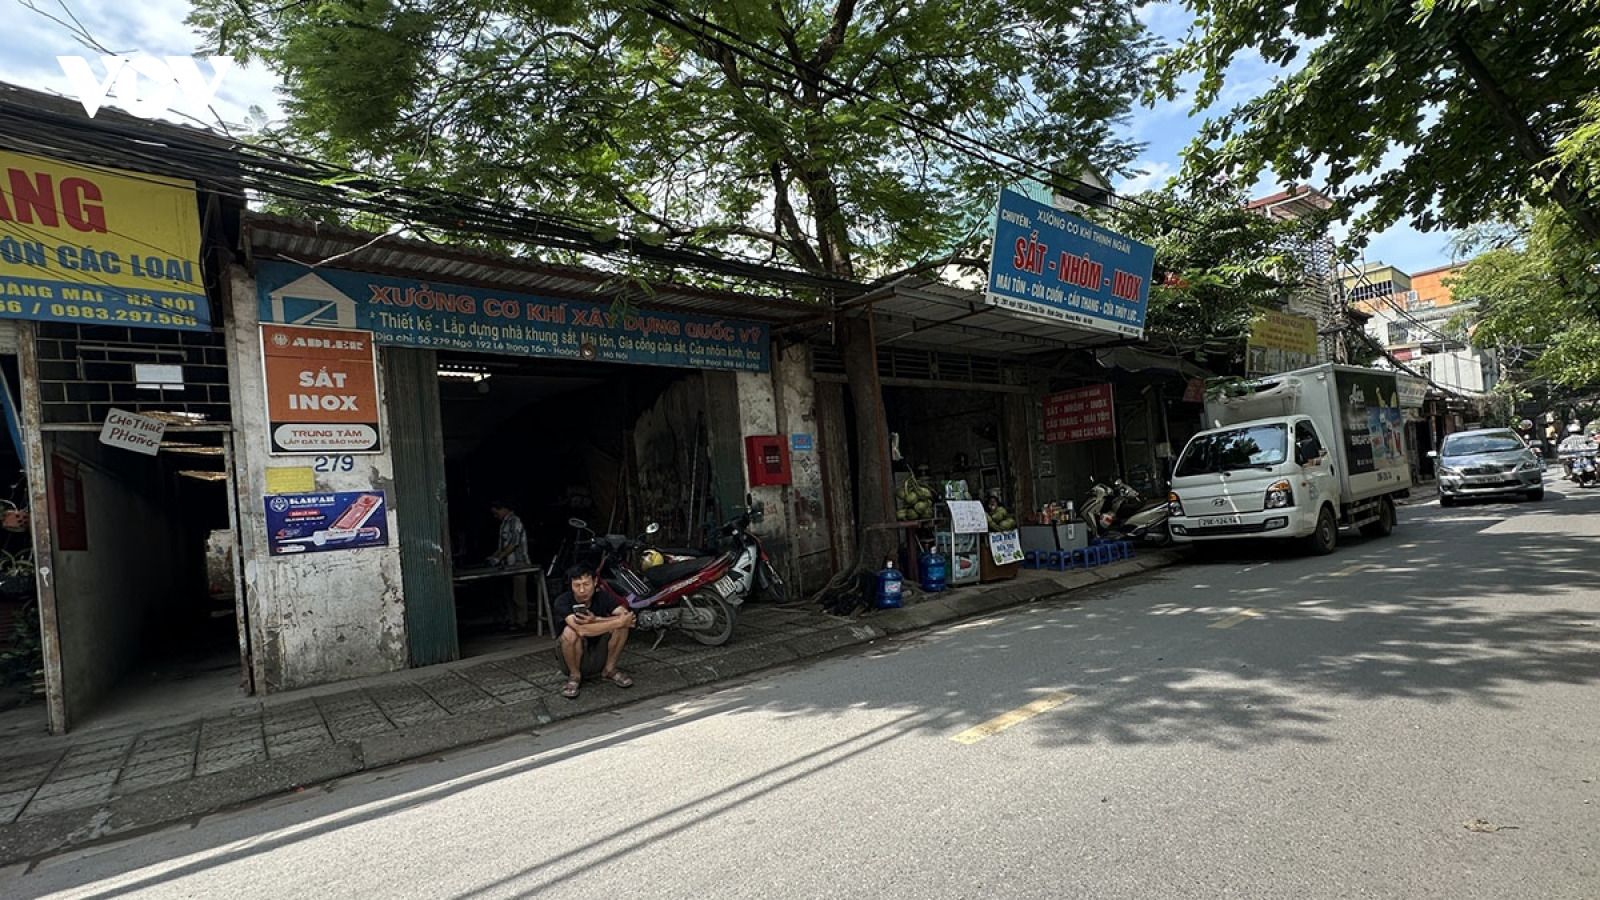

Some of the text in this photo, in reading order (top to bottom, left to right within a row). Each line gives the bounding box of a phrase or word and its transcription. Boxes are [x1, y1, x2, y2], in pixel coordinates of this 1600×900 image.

[1066, 221, 1079, 234] CƠ
[55, 245, 122, 275] CÁC
[130, 254, 194, 286] LOẠI
[1013, 229, 1048, 275] SẮT
[1057, 251, 1104, 292] NHÔM
[1111, 268, 1143, 303] INOX
[995, 273, 1011, 291] MÁI
[1011, 278, 1027, 294] TÔN
[61, 287, 104, 303] MAI
[161, 295, 196, 313] NỘI
[368, 283, 477, 315] XƯỞNG
[483, 298, 521, 319] CƠ
[527, 302, 567, 323] KHÍ
[571, 307, 618, 329] XÂY
[623, 315, 681, 338] DỰNG
[684, 320, 736, 343] QUỐC
[379, 311, 413, 330] Thiết
[417, 314, 433, 331] kế
[443, 315, 466, 337] Lắp
[469, 321, 500, 341] dựng
[502, 324, 522, 340] nhà
[525, 325, 559, 346] khung
[618, 335, 633, 349] Gia
[635, 339, 656, 354] công
[291, 336, 364, 350] ADLER
[433, 337, 450, 345] 279
[476, 339, 492, 349] 192
[299, 366, 348, 389] SẮT
[288, 394, 359, 412] INOX
[108, 414, 132, 426] CHO
[336, 429, 362, 437] TÂM
[314, 455, 354, 473] 279
